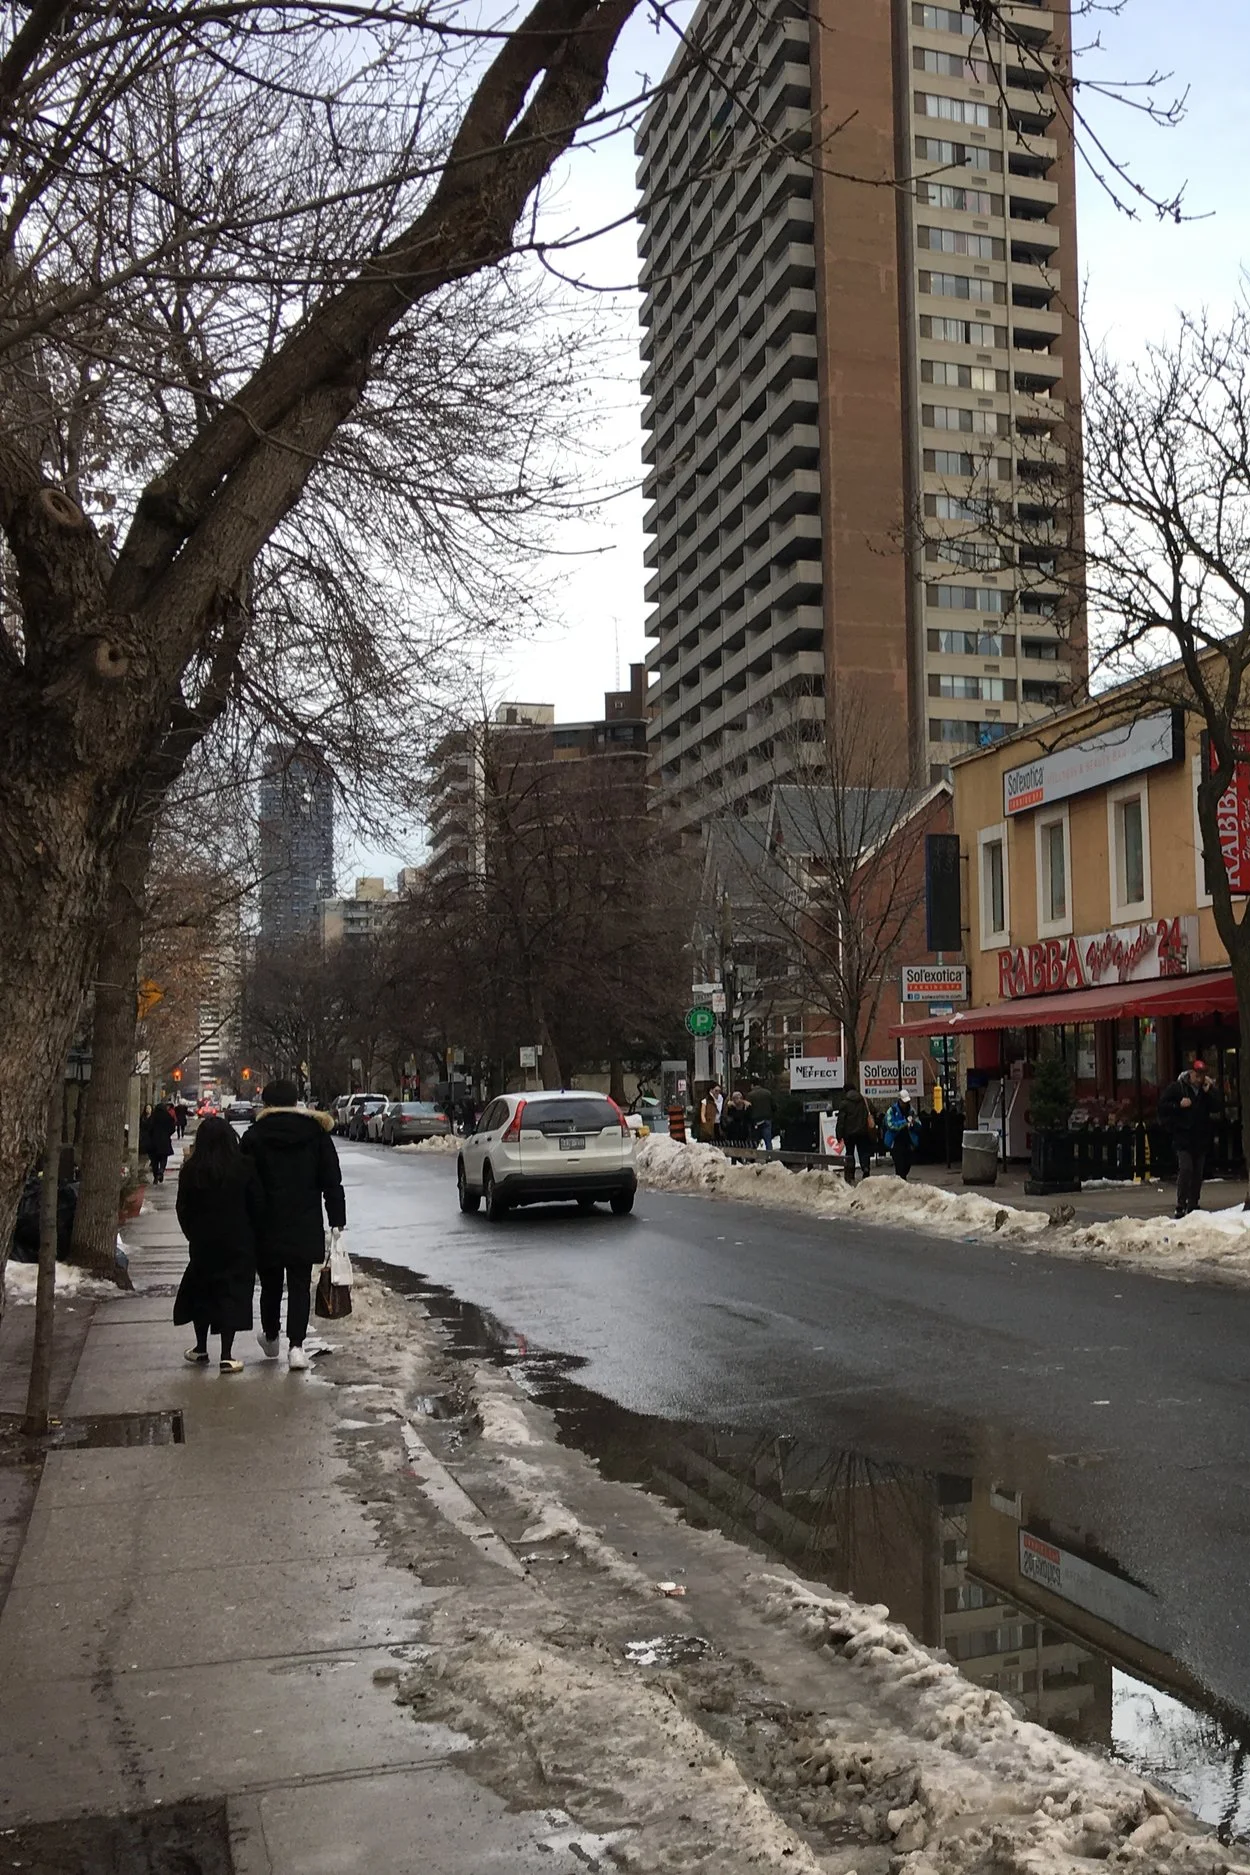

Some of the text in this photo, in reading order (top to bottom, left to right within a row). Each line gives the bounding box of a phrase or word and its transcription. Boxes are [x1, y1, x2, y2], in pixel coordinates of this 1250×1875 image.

[1217, 766, 1241, 887] RABB
[998, 938, 1085, 998] RABBA
[1156, 916, 1182, 957] 24
[906, 968, 962, 983] Sol'exotica
[802, 1069, 838, 1078] EFFECT
[864, 1064, 917, 1078] Sol'exoica
